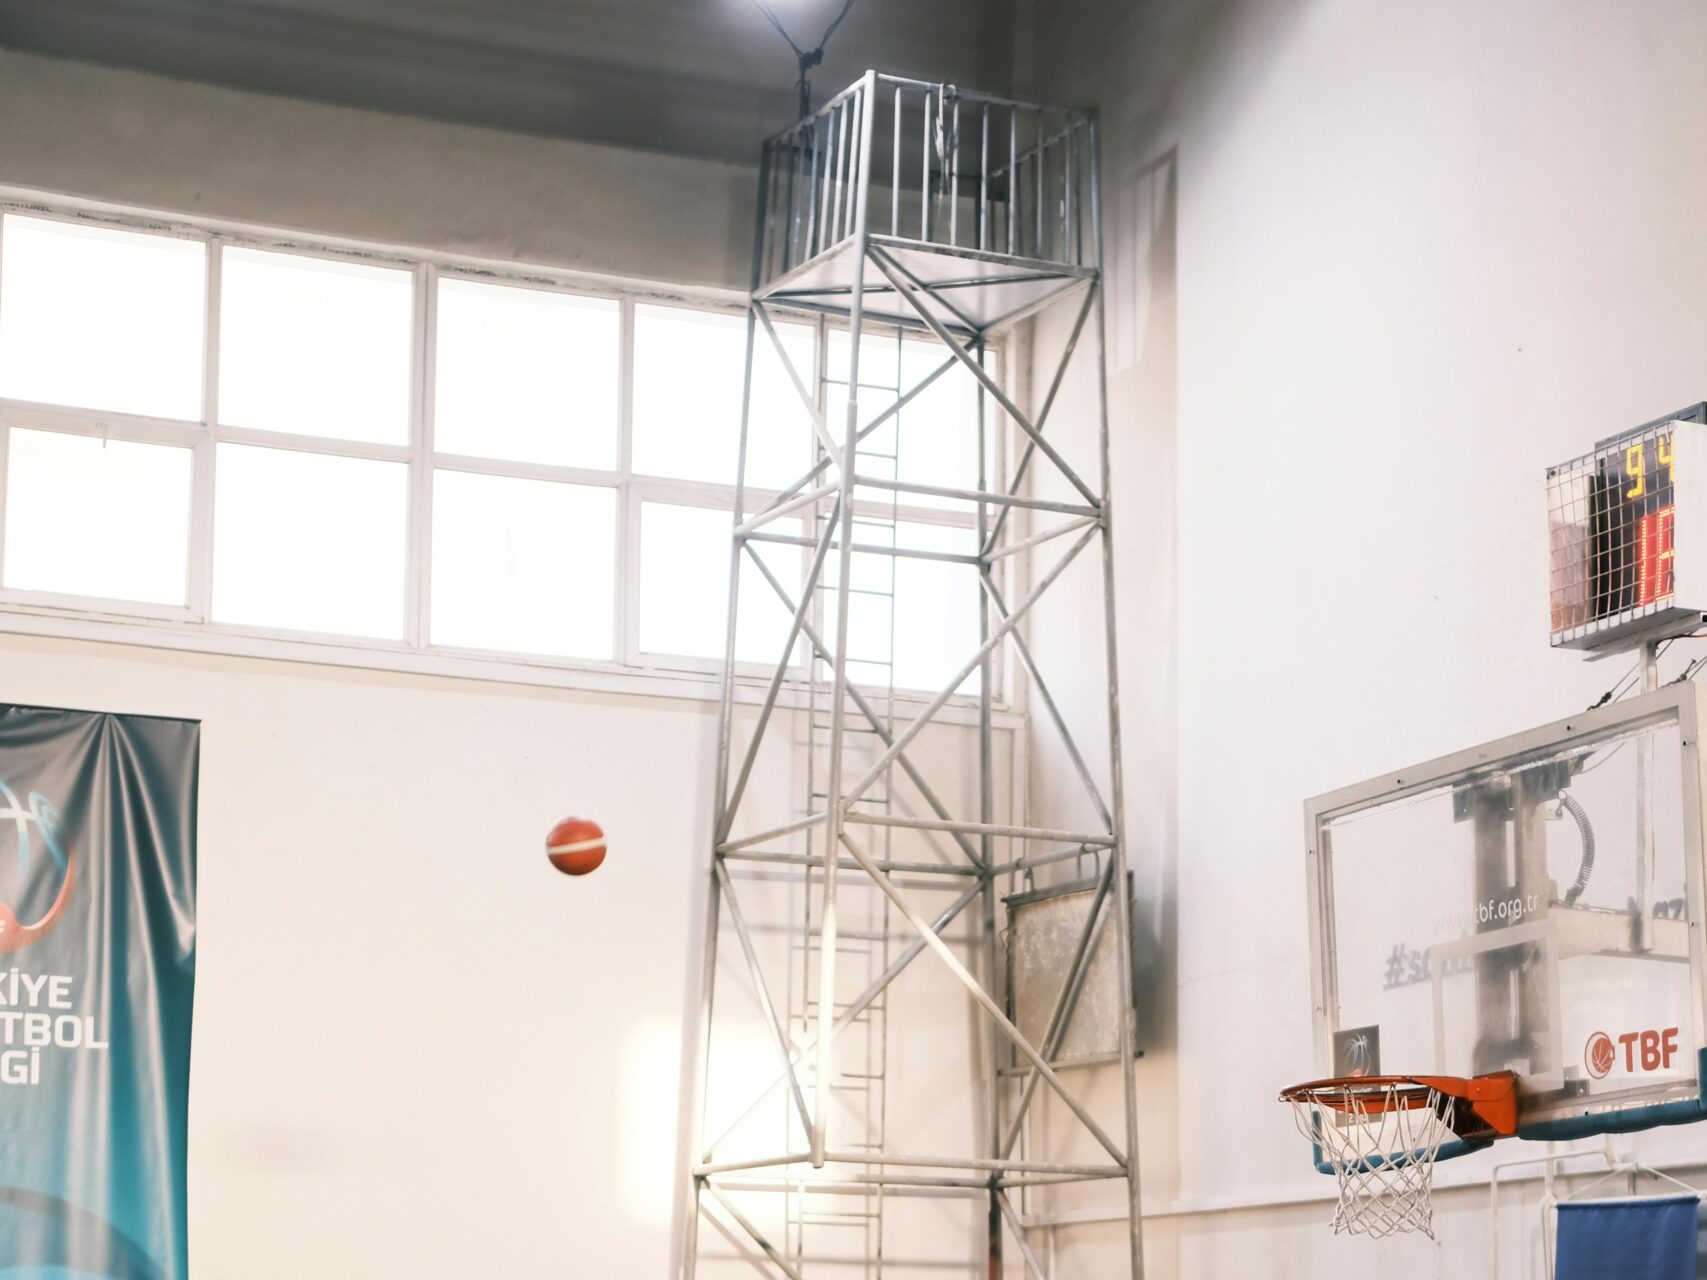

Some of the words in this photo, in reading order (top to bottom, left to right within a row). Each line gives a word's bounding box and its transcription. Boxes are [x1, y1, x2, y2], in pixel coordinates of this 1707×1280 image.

[0, 1011, 109, 1049] TBOL
[0, 1046, 40, 1085] Gİ
[1618, 1027, 1678, 1073] TBF
